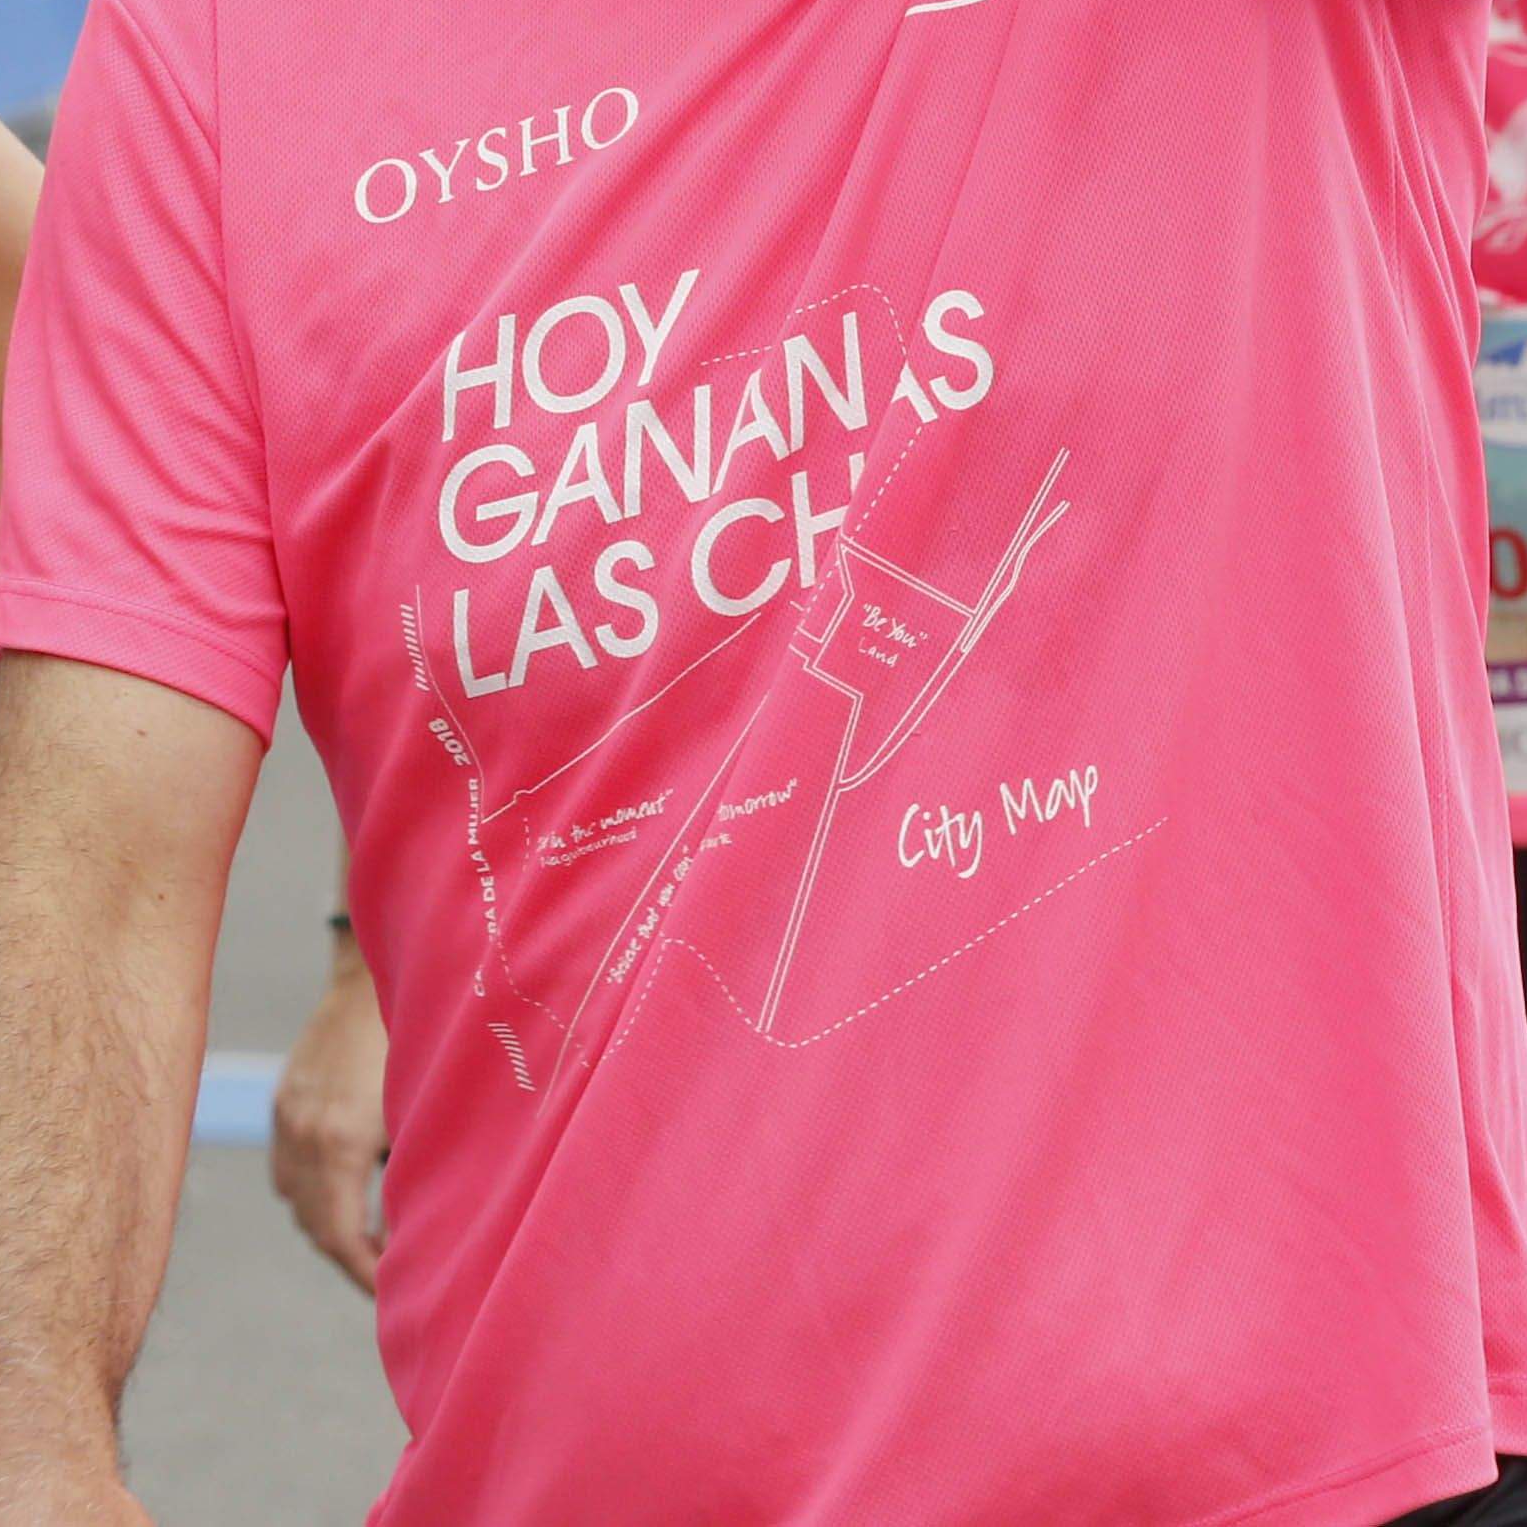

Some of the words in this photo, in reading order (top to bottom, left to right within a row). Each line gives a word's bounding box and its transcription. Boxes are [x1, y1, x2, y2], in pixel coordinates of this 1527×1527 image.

[354, 86, 640, 224] OYSHO
[442, 268, 700, 442] HOY
[438, 311, 867, 563] GANAN
[452, 541, 659, 699] LAS
[428, 717, 472, 766] 2018
[467, 777, 479, 845] MUJER
[898, 801, 984, 879] City
[999, 764, 1099, 836] Map
[480, 875, 496, 903] DE
